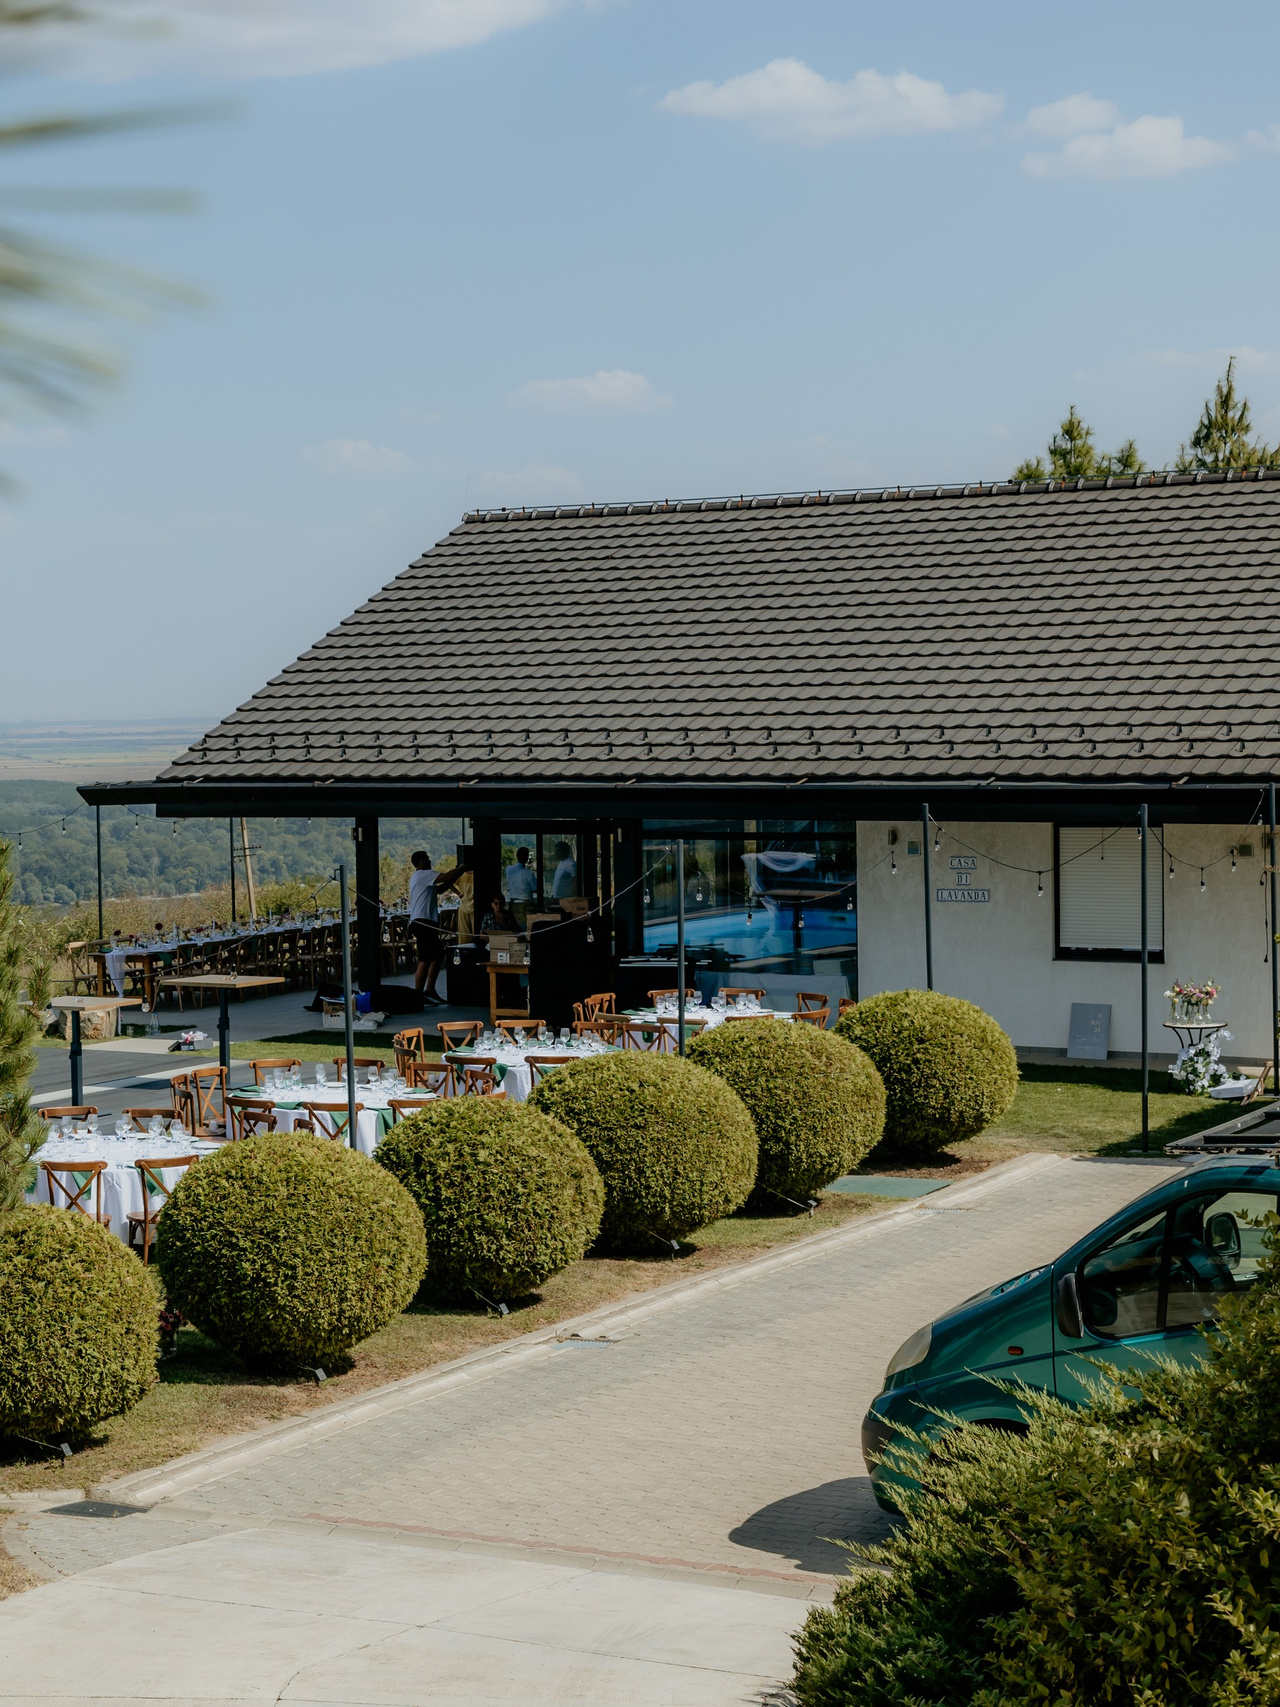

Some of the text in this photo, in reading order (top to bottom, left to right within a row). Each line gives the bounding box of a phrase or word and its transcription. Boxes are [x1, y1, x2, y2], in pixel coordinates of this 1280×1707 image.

[950, 858, 976, 868] CASA
[957, 874, 968, 884] DI
[940, 891, 986, 900] LAVANDA
